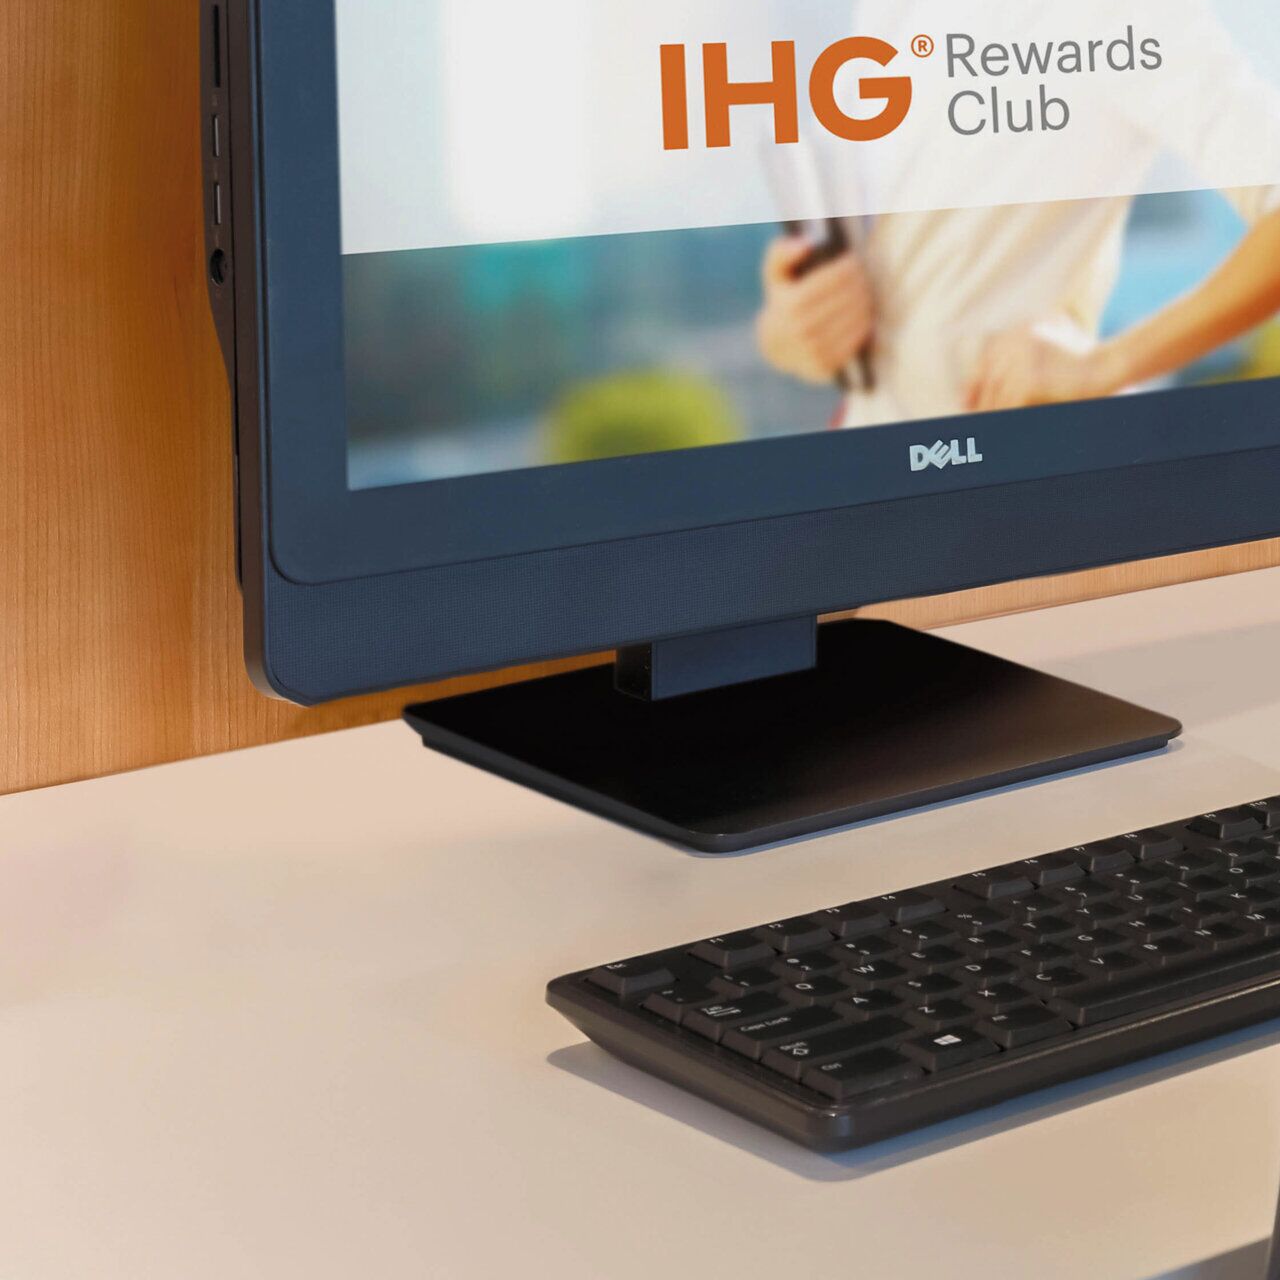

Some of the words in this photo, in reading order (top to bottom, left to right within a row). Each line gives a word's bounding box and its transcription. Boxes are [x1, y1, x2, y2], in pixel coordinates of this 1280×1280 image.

[945, 25, 1163, 78] Rewards
[947, 84, 1071, 137] Club
[909, 437, 983, 472] DELL
